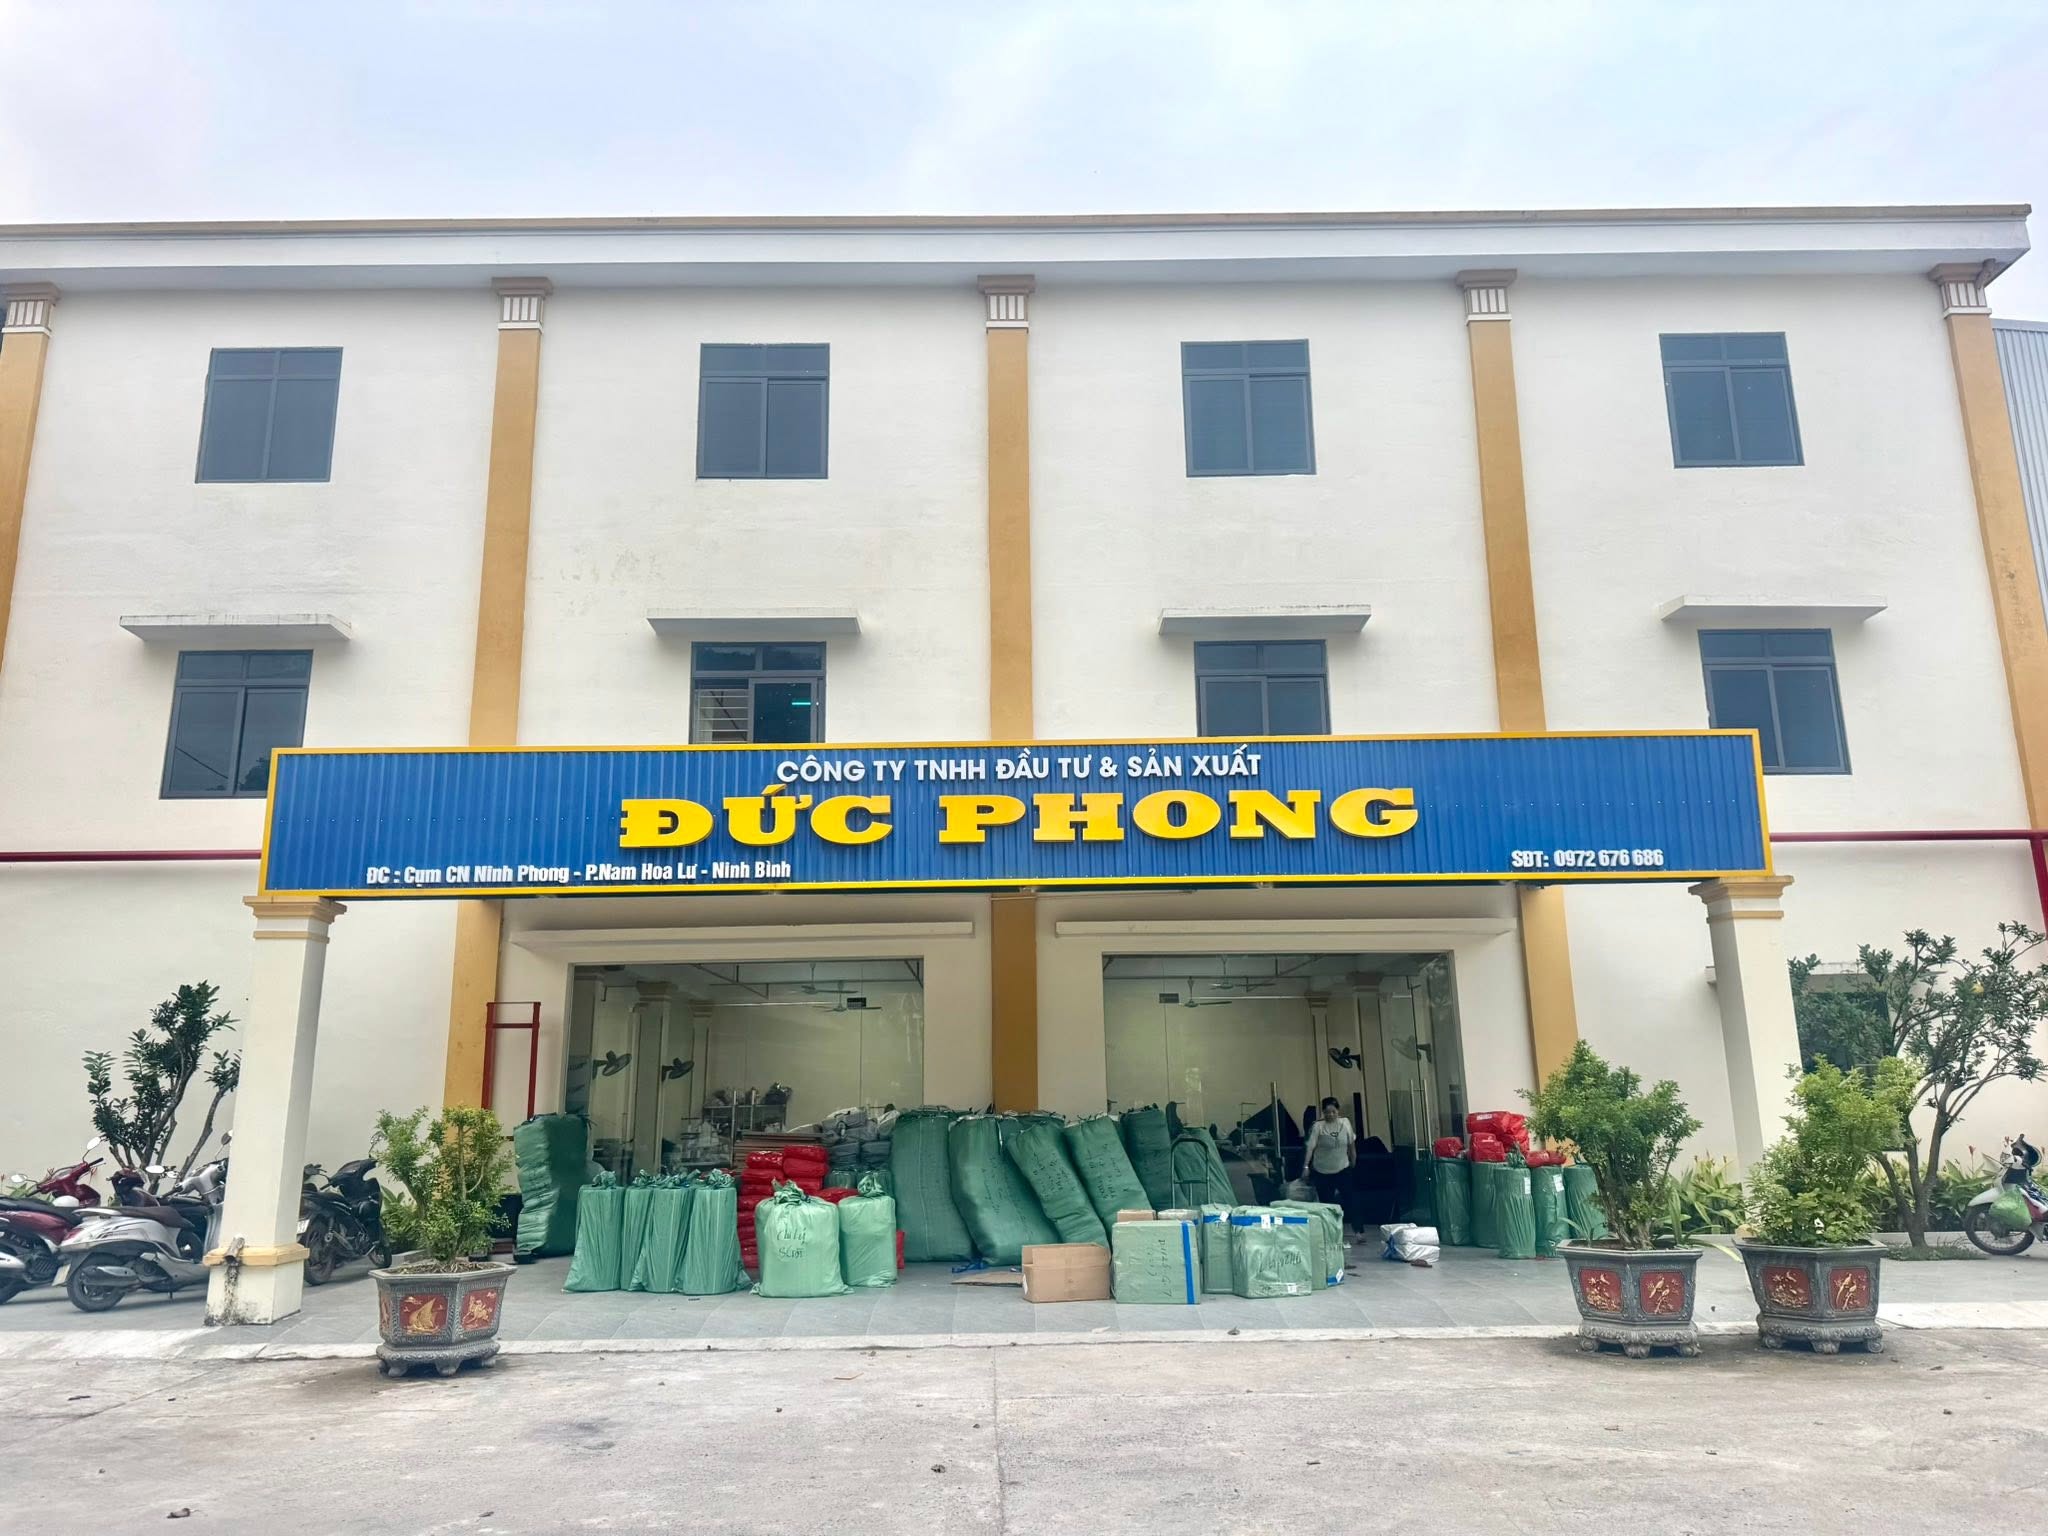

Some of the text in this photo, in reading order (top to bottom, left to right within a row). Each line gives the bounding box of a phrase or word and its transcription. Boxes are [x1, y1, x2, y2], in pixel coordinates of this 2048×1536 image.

[777, 743, 1261, 782] CÔNG TY TNHH ĐẦU TƯ & SẢN XUẤT
[619, 784, 1419, 848] ĐỨC PHONG
[366, 866, 391, 884] ĐC
[404, 866, 442, 887] Cụm
[446, 866, 470, 883] CN
[474, 865, 513, 882] Ninh
[517, 864, 570, 883] Phong
[641, 863, 673, 880] Hoa
[677, 862, 698, 880] Lư
[712, 861, 750, 879] Ninh
[755, 860, 791, 879] Bình
[1511, 849, 1664, 868] SĐT: 0972 676 686
